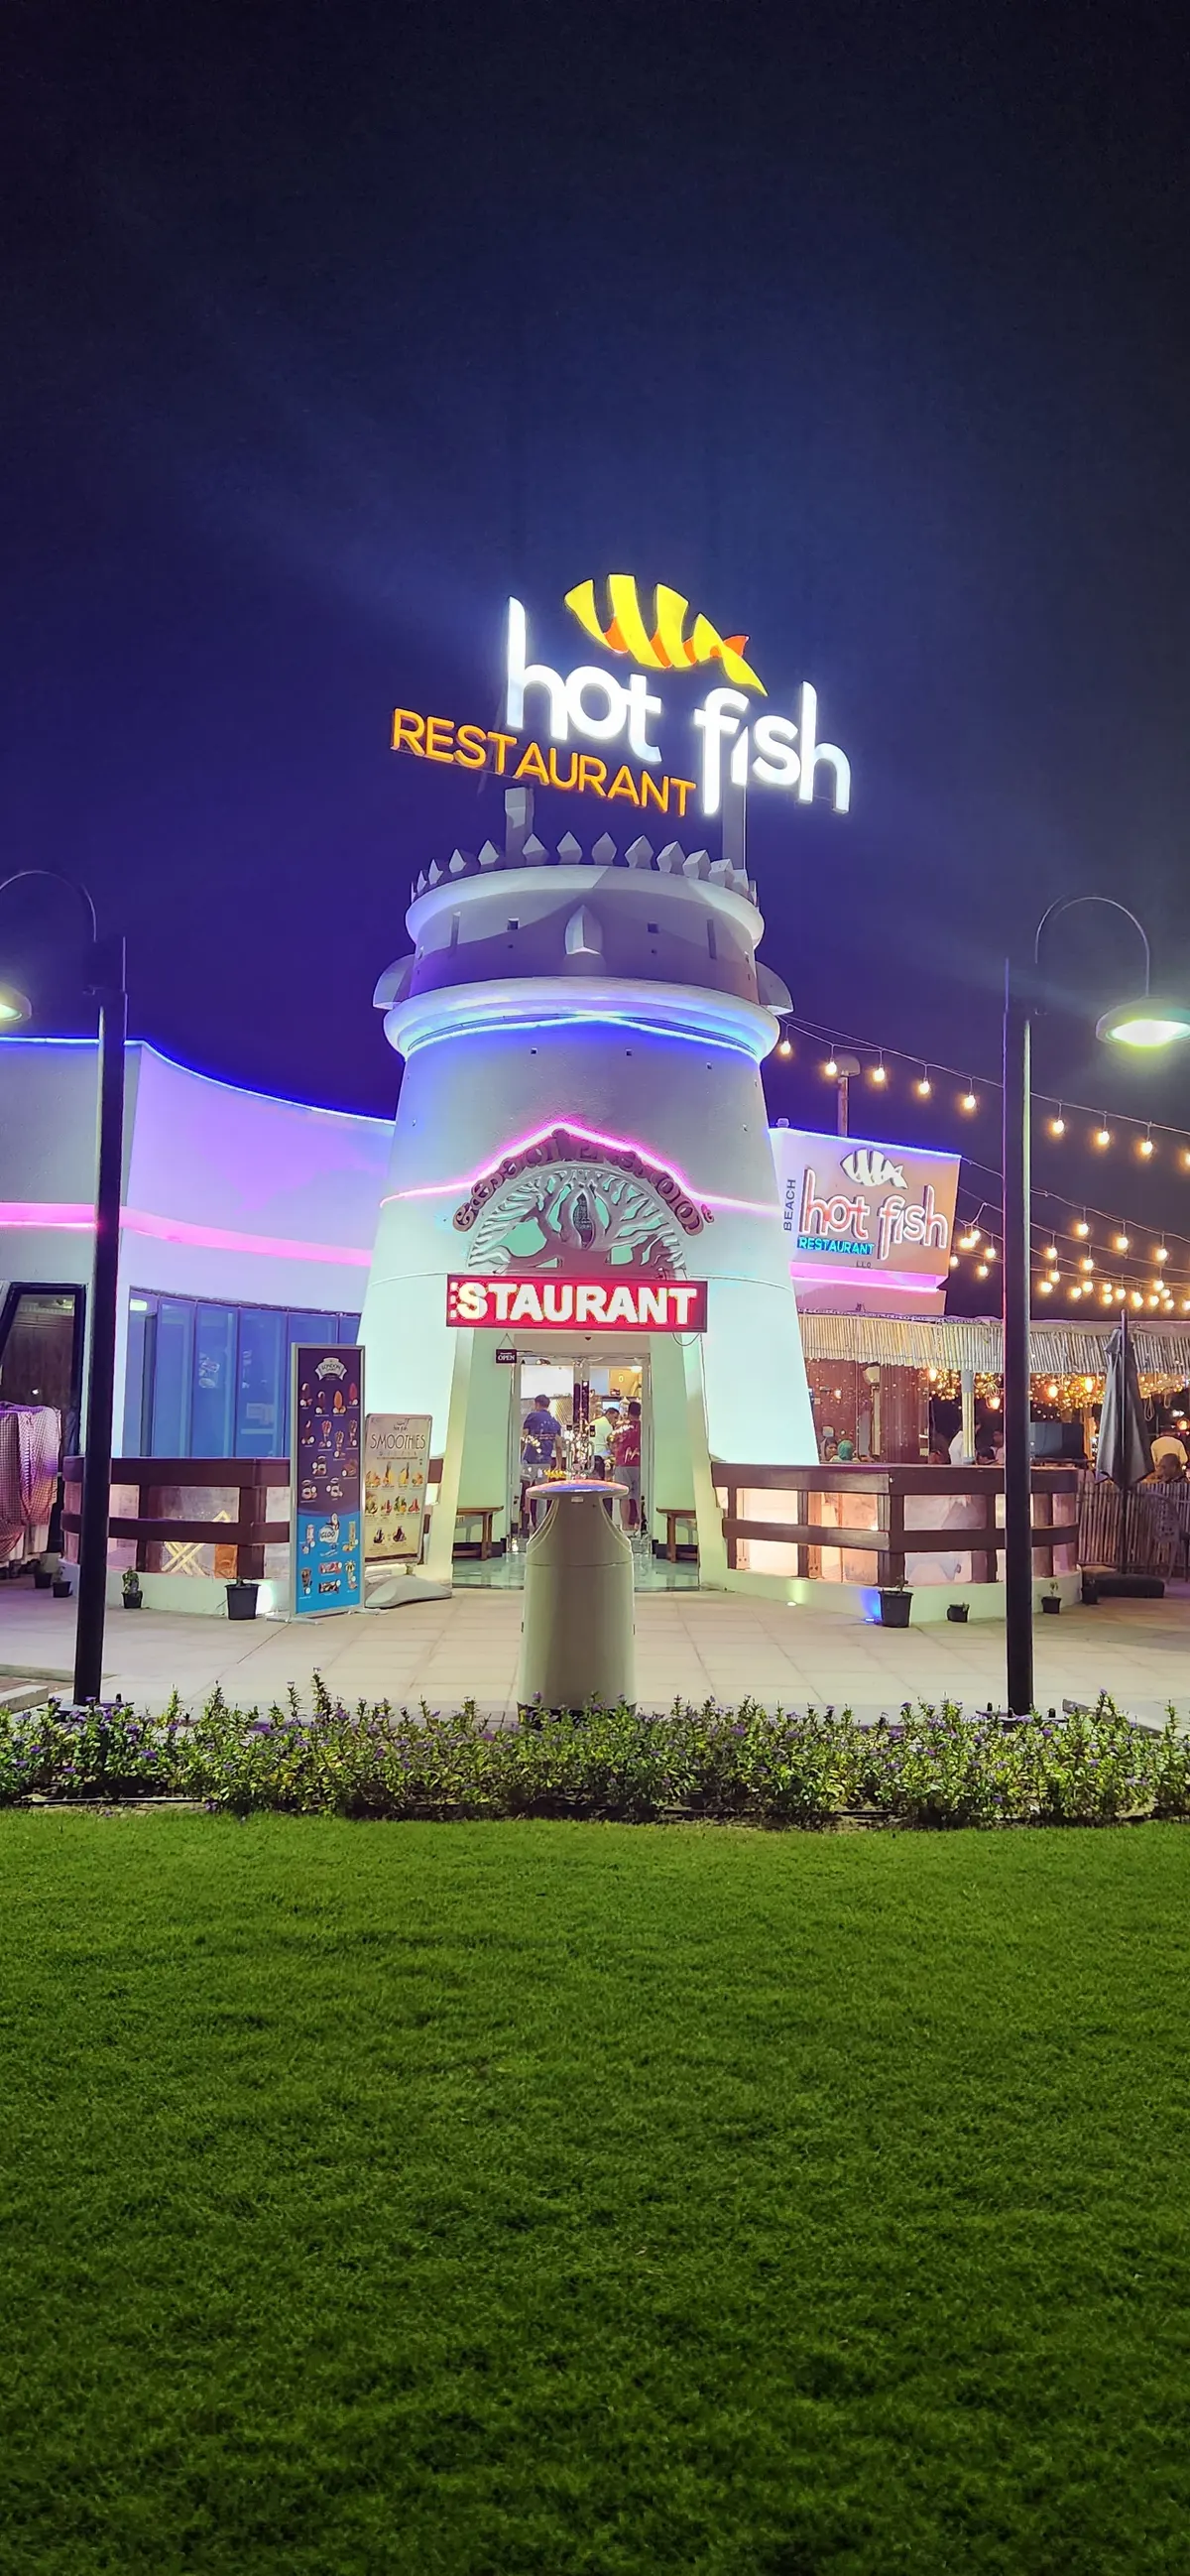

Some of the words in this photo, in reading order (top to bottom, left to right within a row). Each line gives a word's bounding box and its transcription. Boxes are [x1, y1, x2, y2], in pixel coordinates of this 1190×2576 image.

[506, 595, 662, 763] hot
[693, 679, 852, 816] fish
[391, 707, 697, 816] RESTAURANT
[783, 1179, 796, 1231] BEACH
[798, 1167, 871, 1240] hot
[877, 1184, 949, 1261] fish
[797, 1236, 875, 1256] RESTAURANT
[370, 1433, 426, 1449] SMOOTHIES
